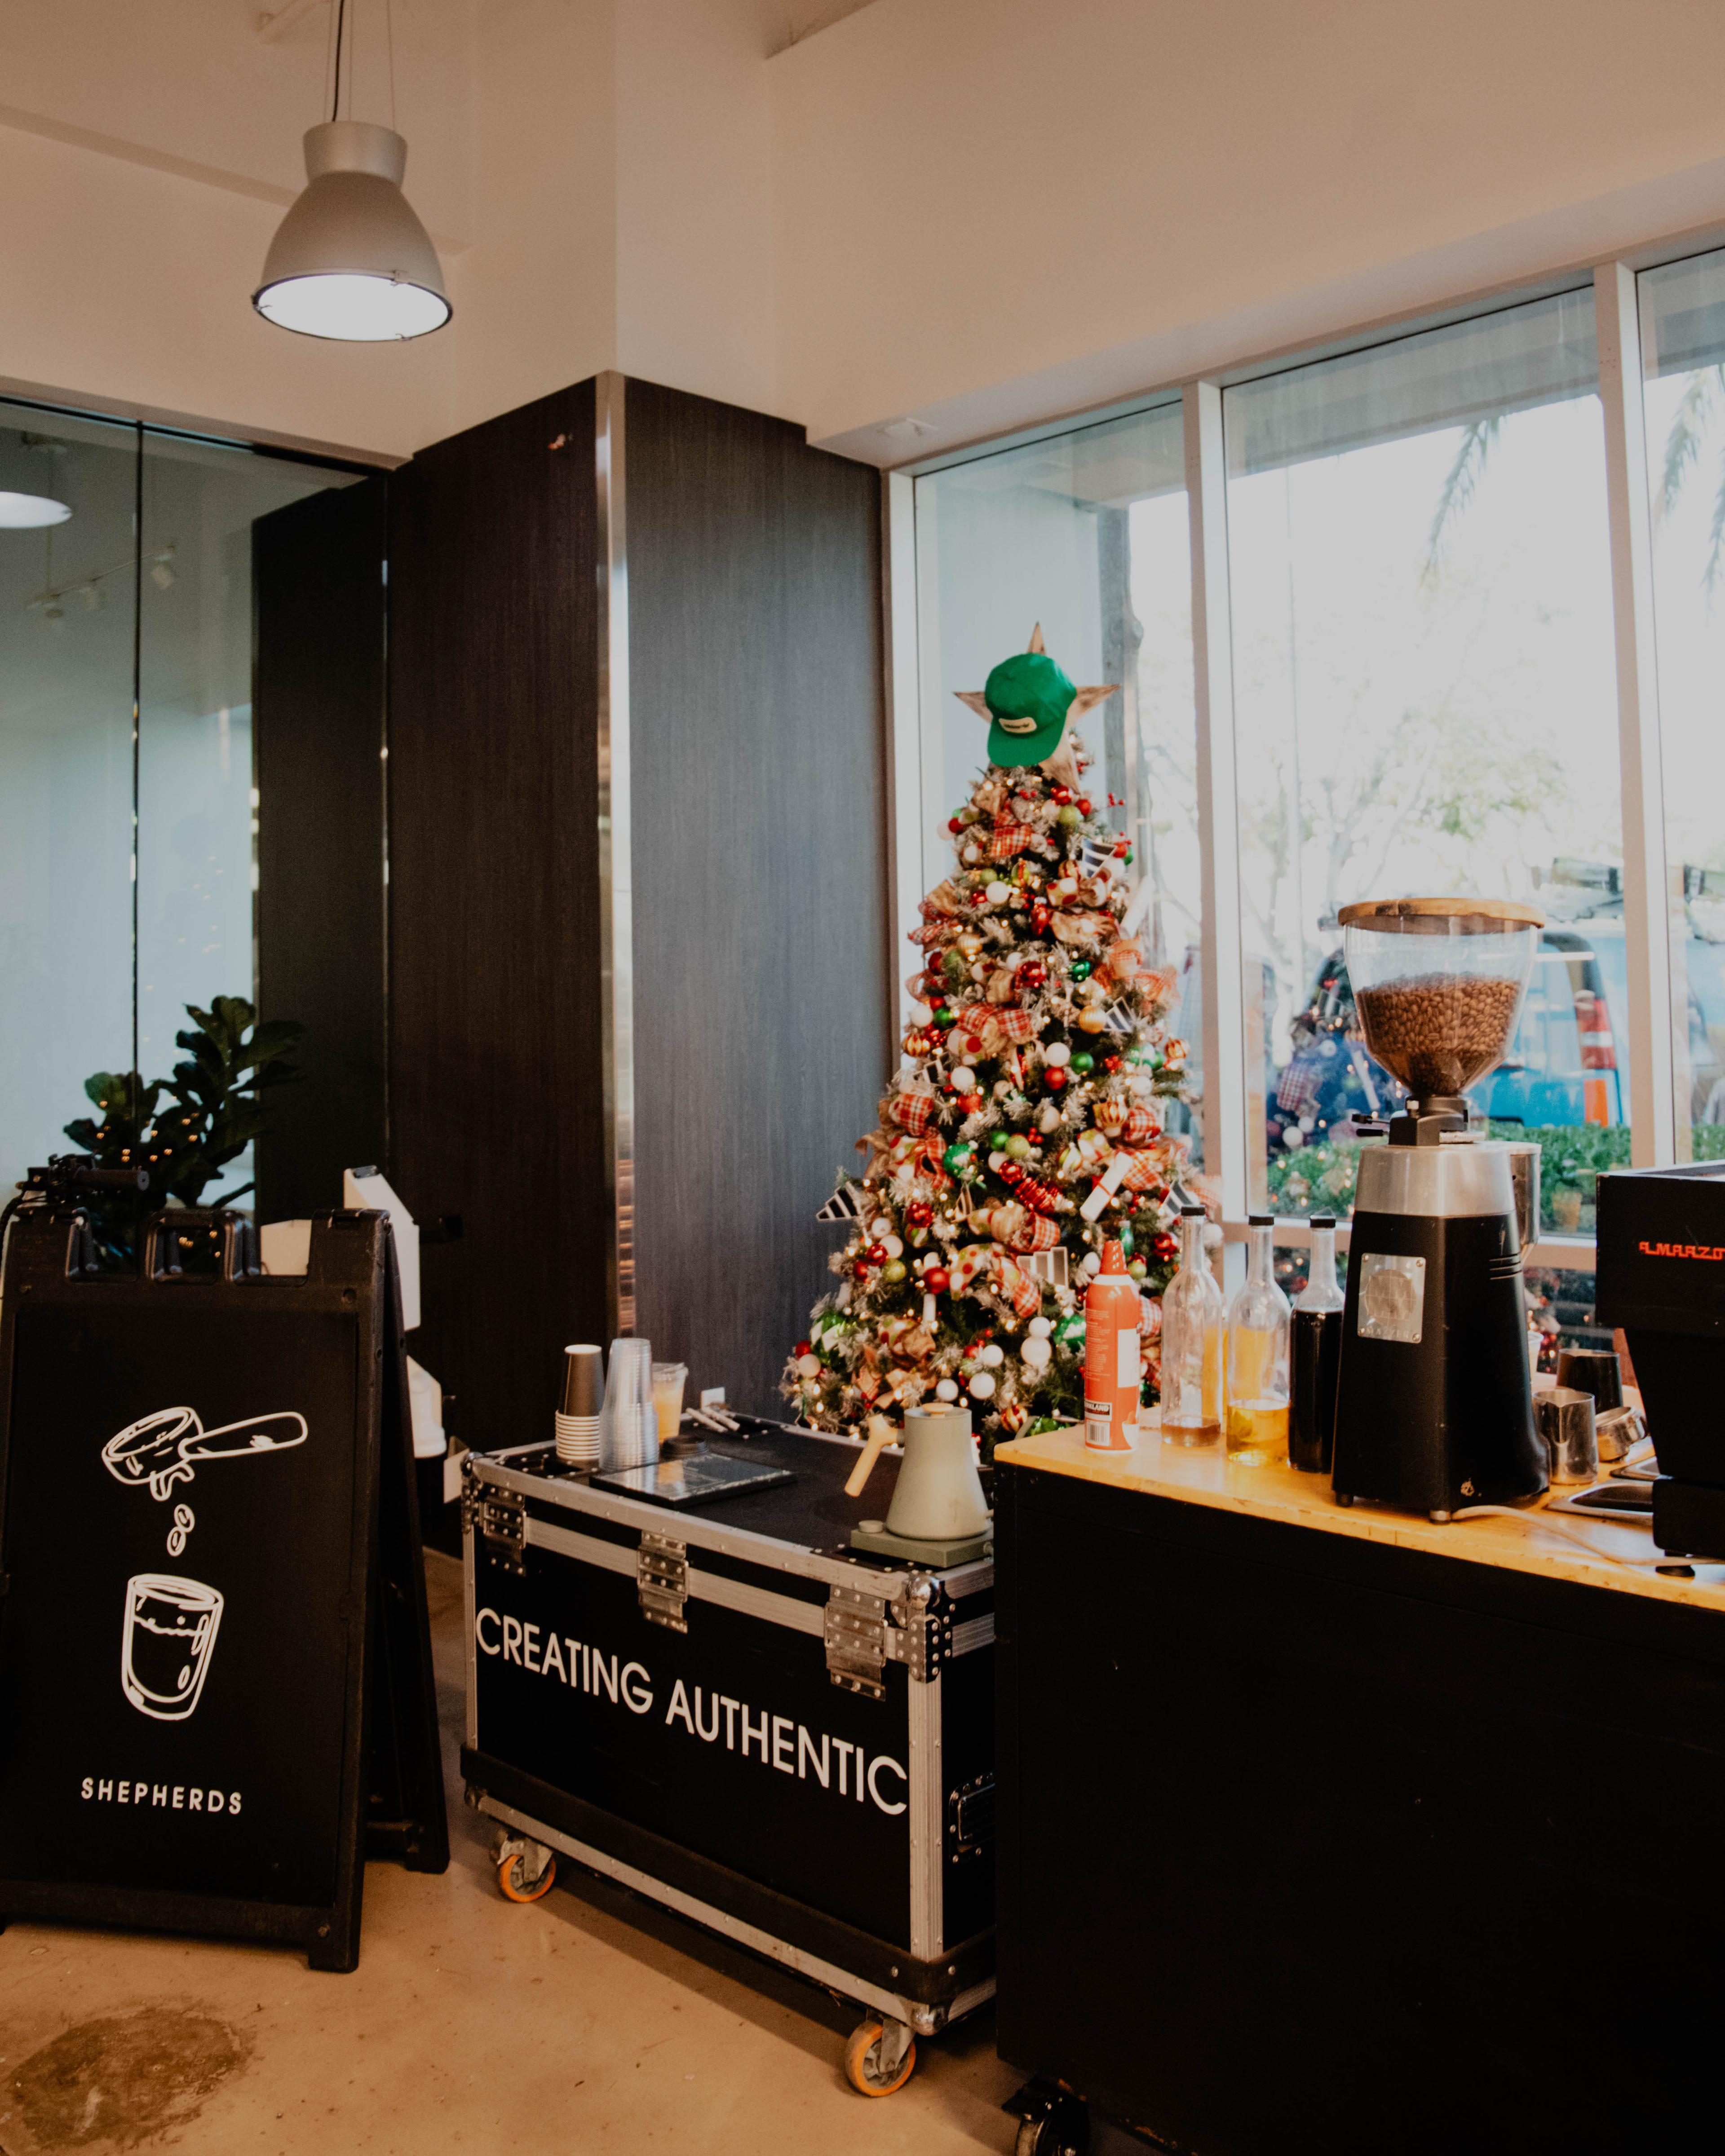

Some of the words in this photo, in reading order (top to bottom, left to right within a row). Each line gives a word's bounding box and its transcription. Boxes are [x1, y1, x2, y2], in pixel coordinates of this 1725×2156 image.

[476, 1608, 653, 1714] CREATING
[665, 1679, 907, 1815] AUTHENTIC
[81, 1777, 242, 1815] SHEPHERDS
